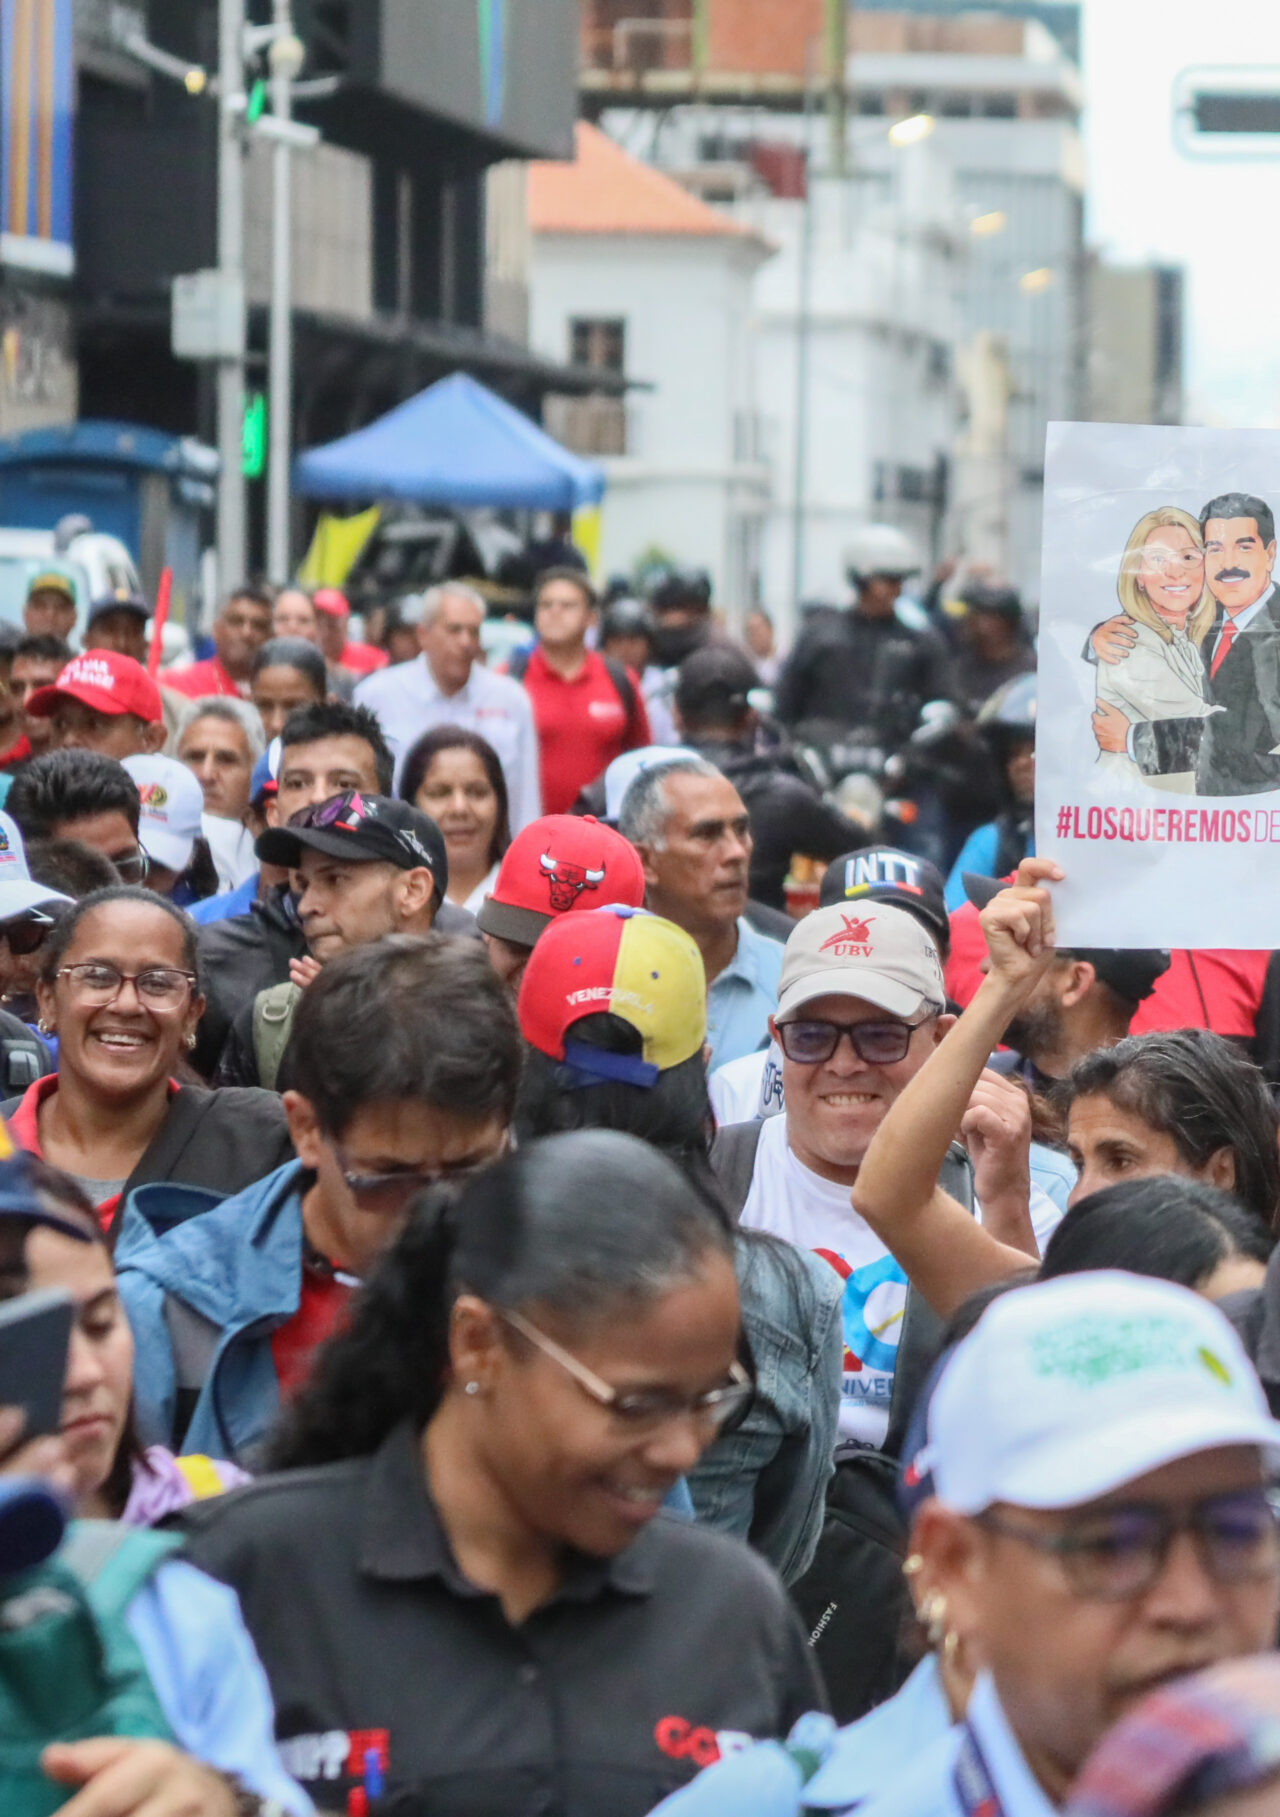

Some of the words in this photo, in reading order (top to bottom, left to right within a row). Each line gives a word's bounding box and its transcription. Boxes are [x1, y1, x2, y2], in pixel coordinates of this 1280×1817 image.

[845, 852, 920, 888] INTT
[834, 944, 875, 958] UBV
[565, 987, 655, 1016] VENEZUELA
[840, 1377, 894, 1397] NIVE
[806, 1601, 838, 1647] FASHION
[654, 1714, 754, 1769] GGP
